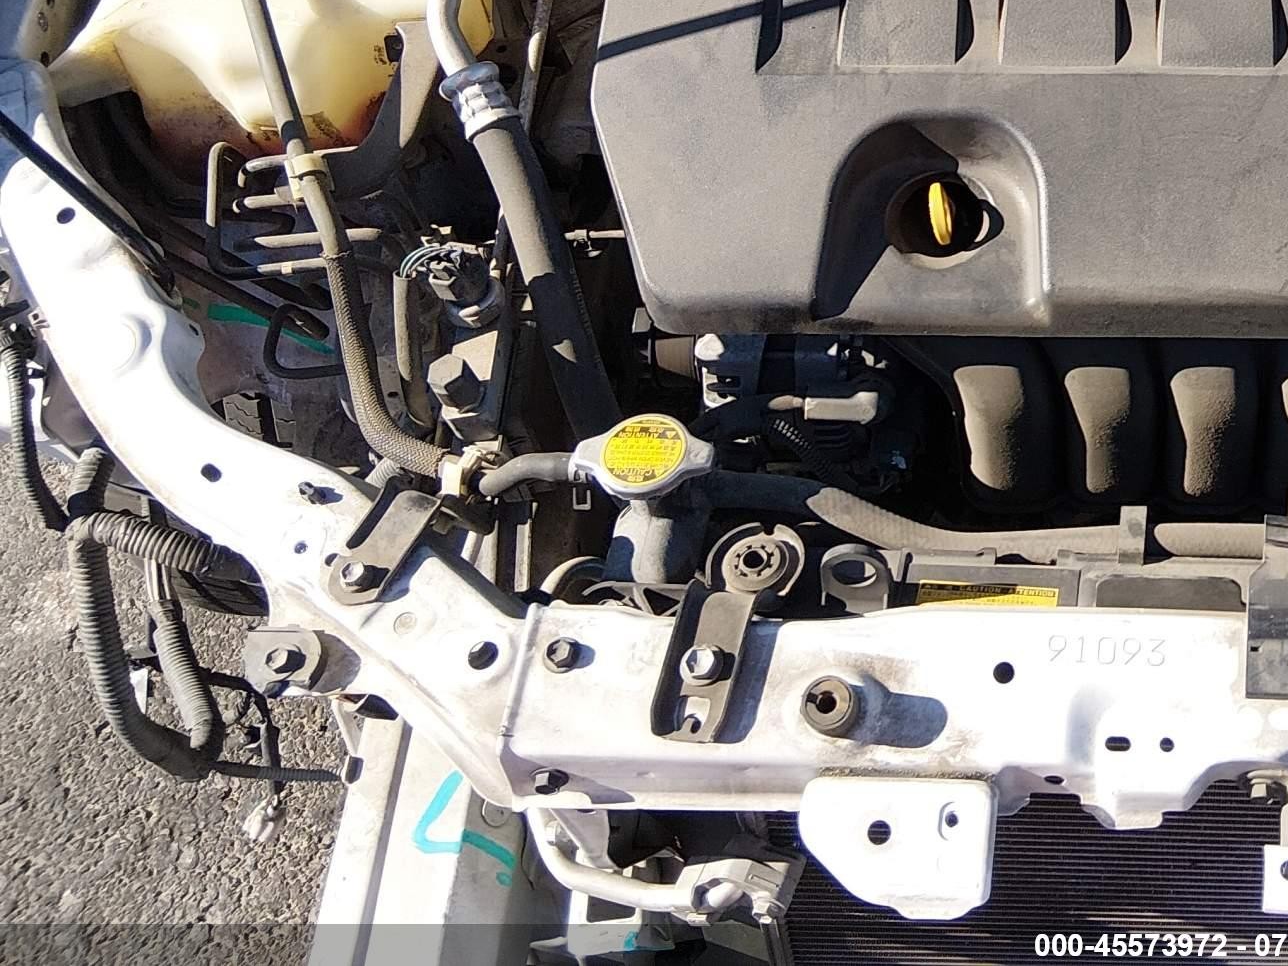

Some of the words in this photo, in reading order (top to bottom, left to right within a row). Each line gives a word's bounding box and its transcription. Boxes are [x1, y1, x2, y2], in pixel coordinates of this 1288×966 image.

[612, 467, 653, 476] CAUTION
[959, 585, 1002, 594] CAUTION
[1008, 587, 1056, 598] ATTENTION
[1049, 634, 1167, 667] 91093
